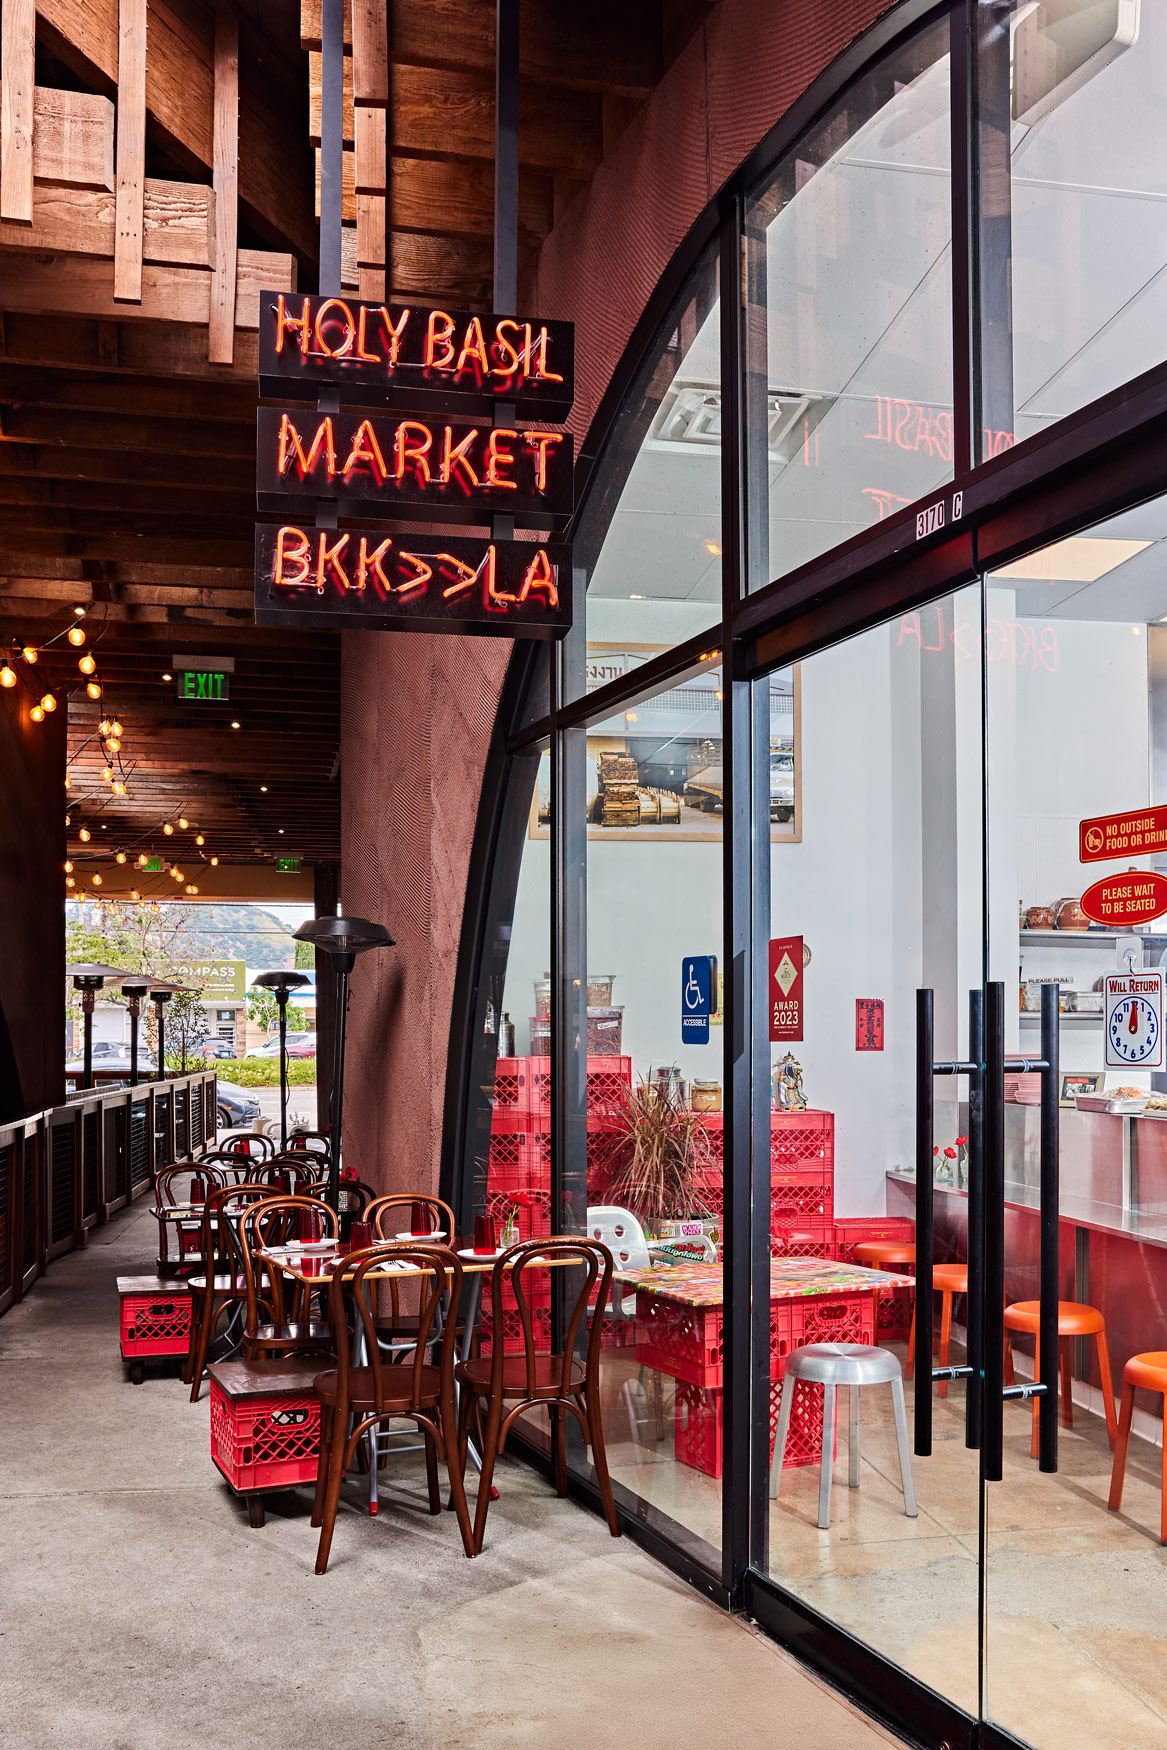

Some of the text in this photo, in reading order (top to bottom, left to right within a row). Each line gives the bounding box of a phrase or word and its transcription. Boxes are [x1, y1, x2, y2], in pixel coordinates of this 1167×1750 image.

[276, 295, 563, 382] HOLY BASIL
[279, 414, 563, 490] MARKET
[918, 503, 944, 537] 3170
[954, 494, 961, 518] C
[184, 673, 224, 699] EXIT
[1106, 818, 1155, 836] NO OUTSIDE
[1106, 837, 1128, 850] FOOD
[1131, 835, 1142, 846] OR
[145, 858, 161, 871] EXIT
[279, 859, 299, 871] EXIT
[1102, 884, 1155, 900] PLEASE WAIT
[1101, 899, 1155, 914] TO BE SEATED
[1109, 979, 1159, 993] WILL RETURN
[774, 1001, 799, 1011] AWARD
[1123, 1003, 1129, 1012] 11
[774, 1011, 799, 1025] 2023
[1114, 1013, 1123, 1023] 10
[1147, 1012, 1152, 1021] 2
[1112, 1025, 1117, 1035] 9
[1150, 1024, 1155, 1033] 3
[1116, 1037, 1121, 1047] 8
[1146, 1036, 1152, 1046] 4
[1123, 1045, 1128, 1054] 7
[1131, 1049, 1136, 1059] 6
[1140, 1045, 1145, 1055] 5
